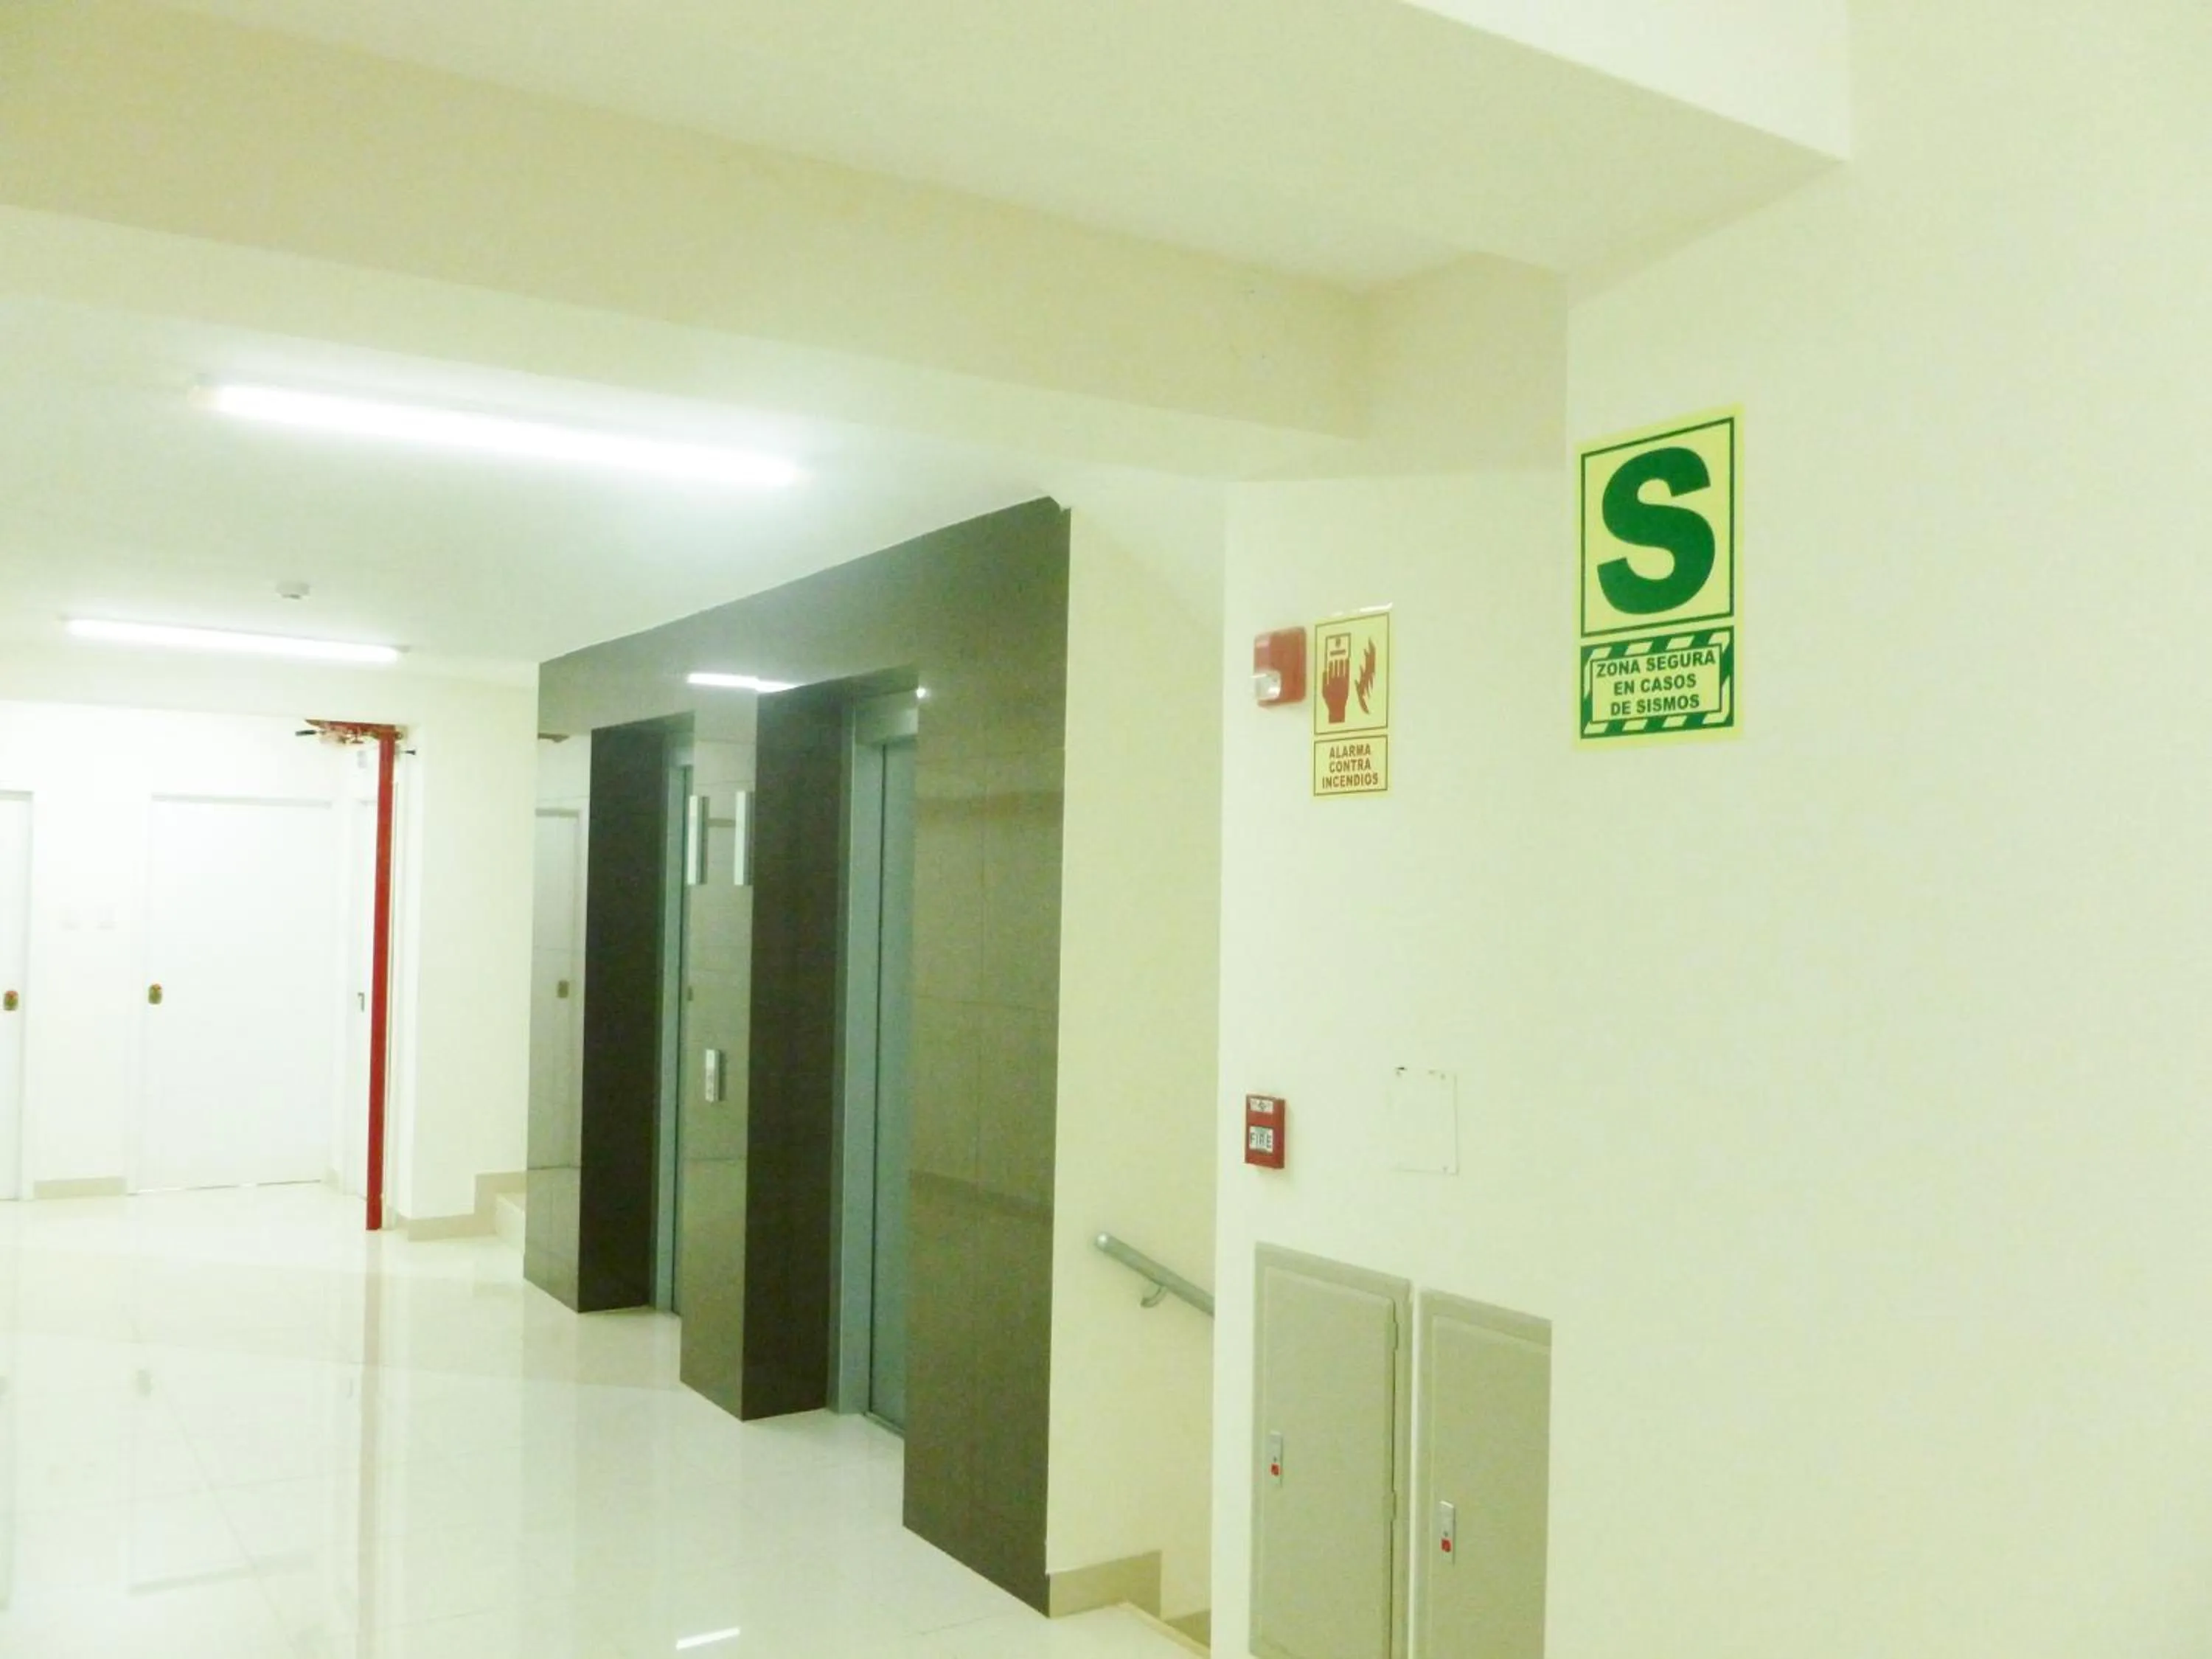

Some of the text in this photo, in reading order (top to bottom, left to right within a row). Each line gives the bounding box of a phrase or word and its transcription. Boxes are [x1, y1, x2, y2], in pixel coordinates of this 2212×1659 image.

[1597, 447, 1715, 614] S
[1596, 649, 1716, 678] ZONA SEGURA
[1614, 673, 1697, 696] EN CASOS
[1610, 694, 1700, 717] DE SISMOS
[1329, 743, 1371, 758] ALARMA
[1329, 758, 1371, 773] CONTRA
[1322, 772, 1378, 789] INCENDIOS
